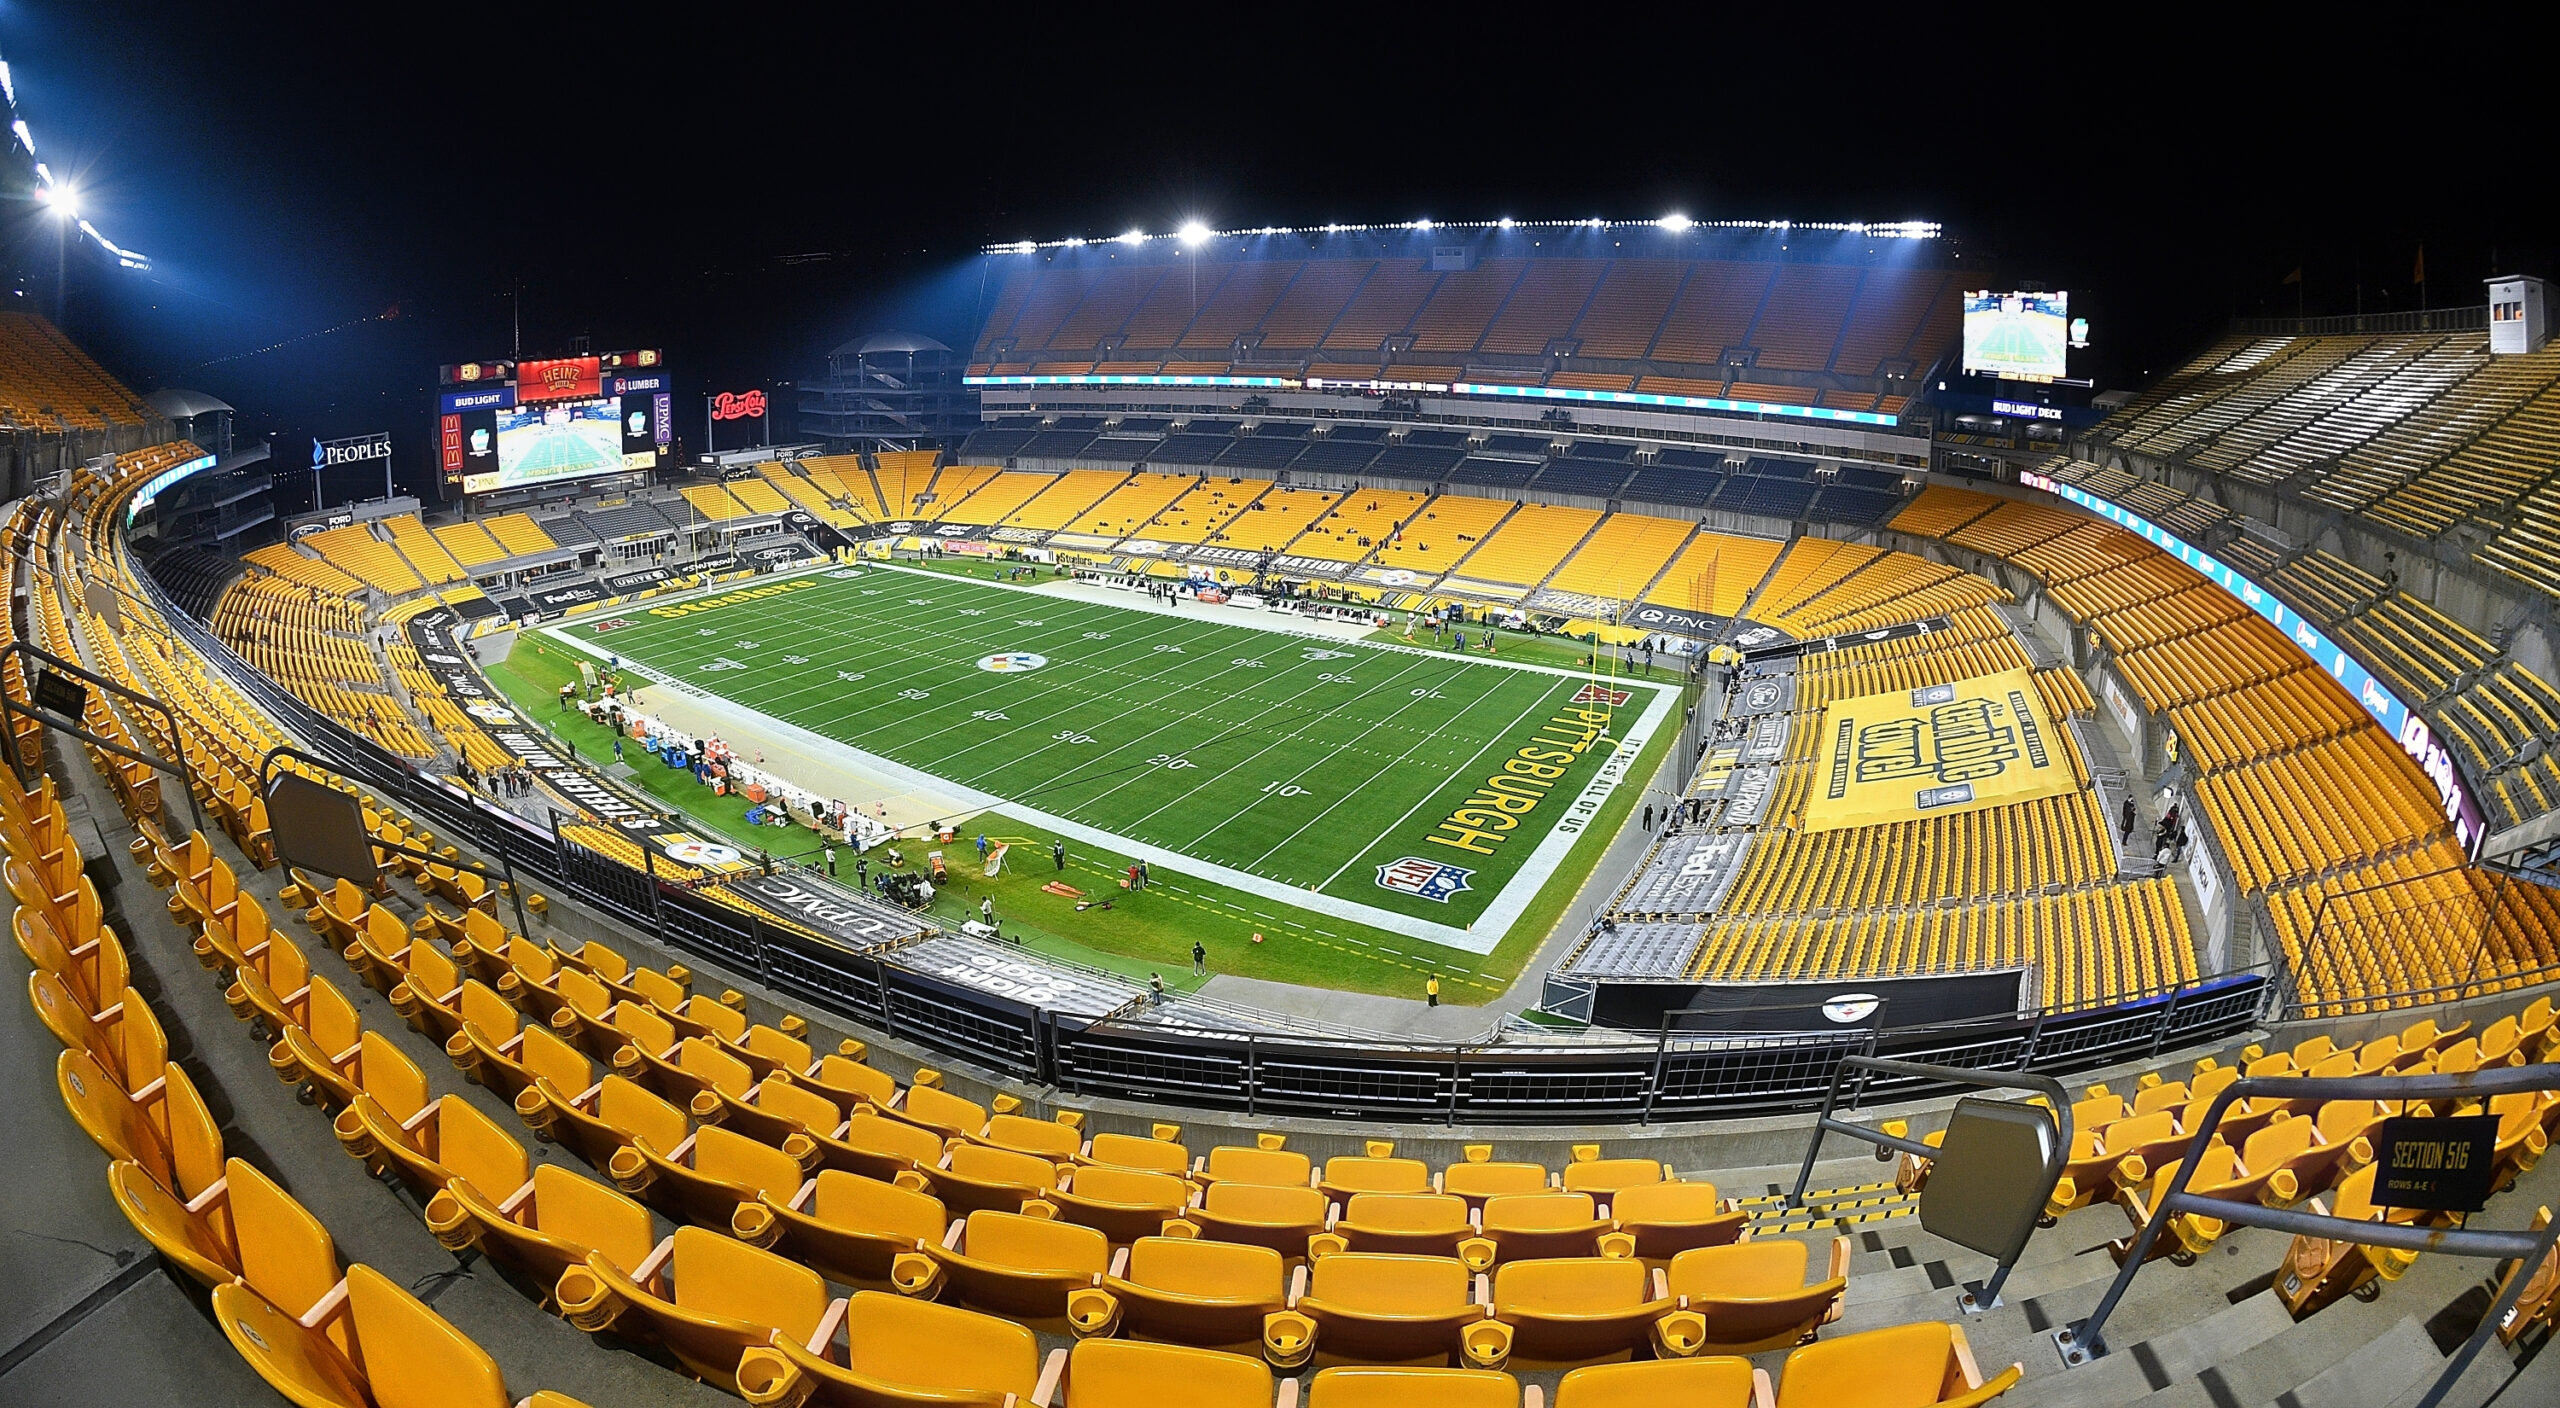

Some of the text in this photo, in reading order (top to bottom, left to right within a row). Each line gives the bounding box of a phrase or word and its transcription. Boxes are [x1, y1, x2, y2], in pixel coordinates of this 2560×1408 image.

[542, 366, 581, 383] HEINZ
[615, 379, 660, 391] 84 LUMBER
[455, 394, 500, 407] BUD LIGHT
[659, 396, 670, 439] UPMC
[1993, 402, 2062, 419] BUD LIGHT DECK
[326, 441, 391, 465] PEOPLES
[329, 515, 351, 525] FORD
[1060, 552, 1093, 565] Steelers
[1273, 555, 1348, 573] NATION
[647, 580, 817, 618] Steelers
[1665, 613, 1717, 630] PNC
[1282, 629, 1350, 642] CHANGE
[1356, 640, 1429, 653] INSPIRE
[898, 688, 930, 700] 50
[971, 710, 1006, 720] 40
[1052, 730, 1091, 744] 30
[1625, 738, 1643, 747] IT
[1931, 698, 2019, 784] Terrible
[495, 733, 566, 768] NATION
[1856, 717, 1930, 783] Towel
[2025, 733, 2046, 765] OFFICIAL
[1146, 754, 1189, 769] 20
[1261, 781, 1302, 796] 10
[1424, 706, 1612, 856] PITTSBURGH
[1586, 778, 1612, 796] ALL
[1830, 762, 1847, 797] ORIGINAL
[545, 771, 661, 829] STEELERS
[1574, 800, 1598, 818] OF
[1558, 818, 1585, 834] US
[1386, 861, 1433, 887] NFL
[1664, 845, 1730, 898] FedEx
[758, 882, 887, 934] UPMC
[970, 955, 1077, 990] eagle
[940, 963, 1060, 1001] giant
[2392, 1141, 2471, 1170] SECTION 516
[2388, 1180, 2428, 1190] ROWS A-E
[2287, 1278, 2298, 1291] D
